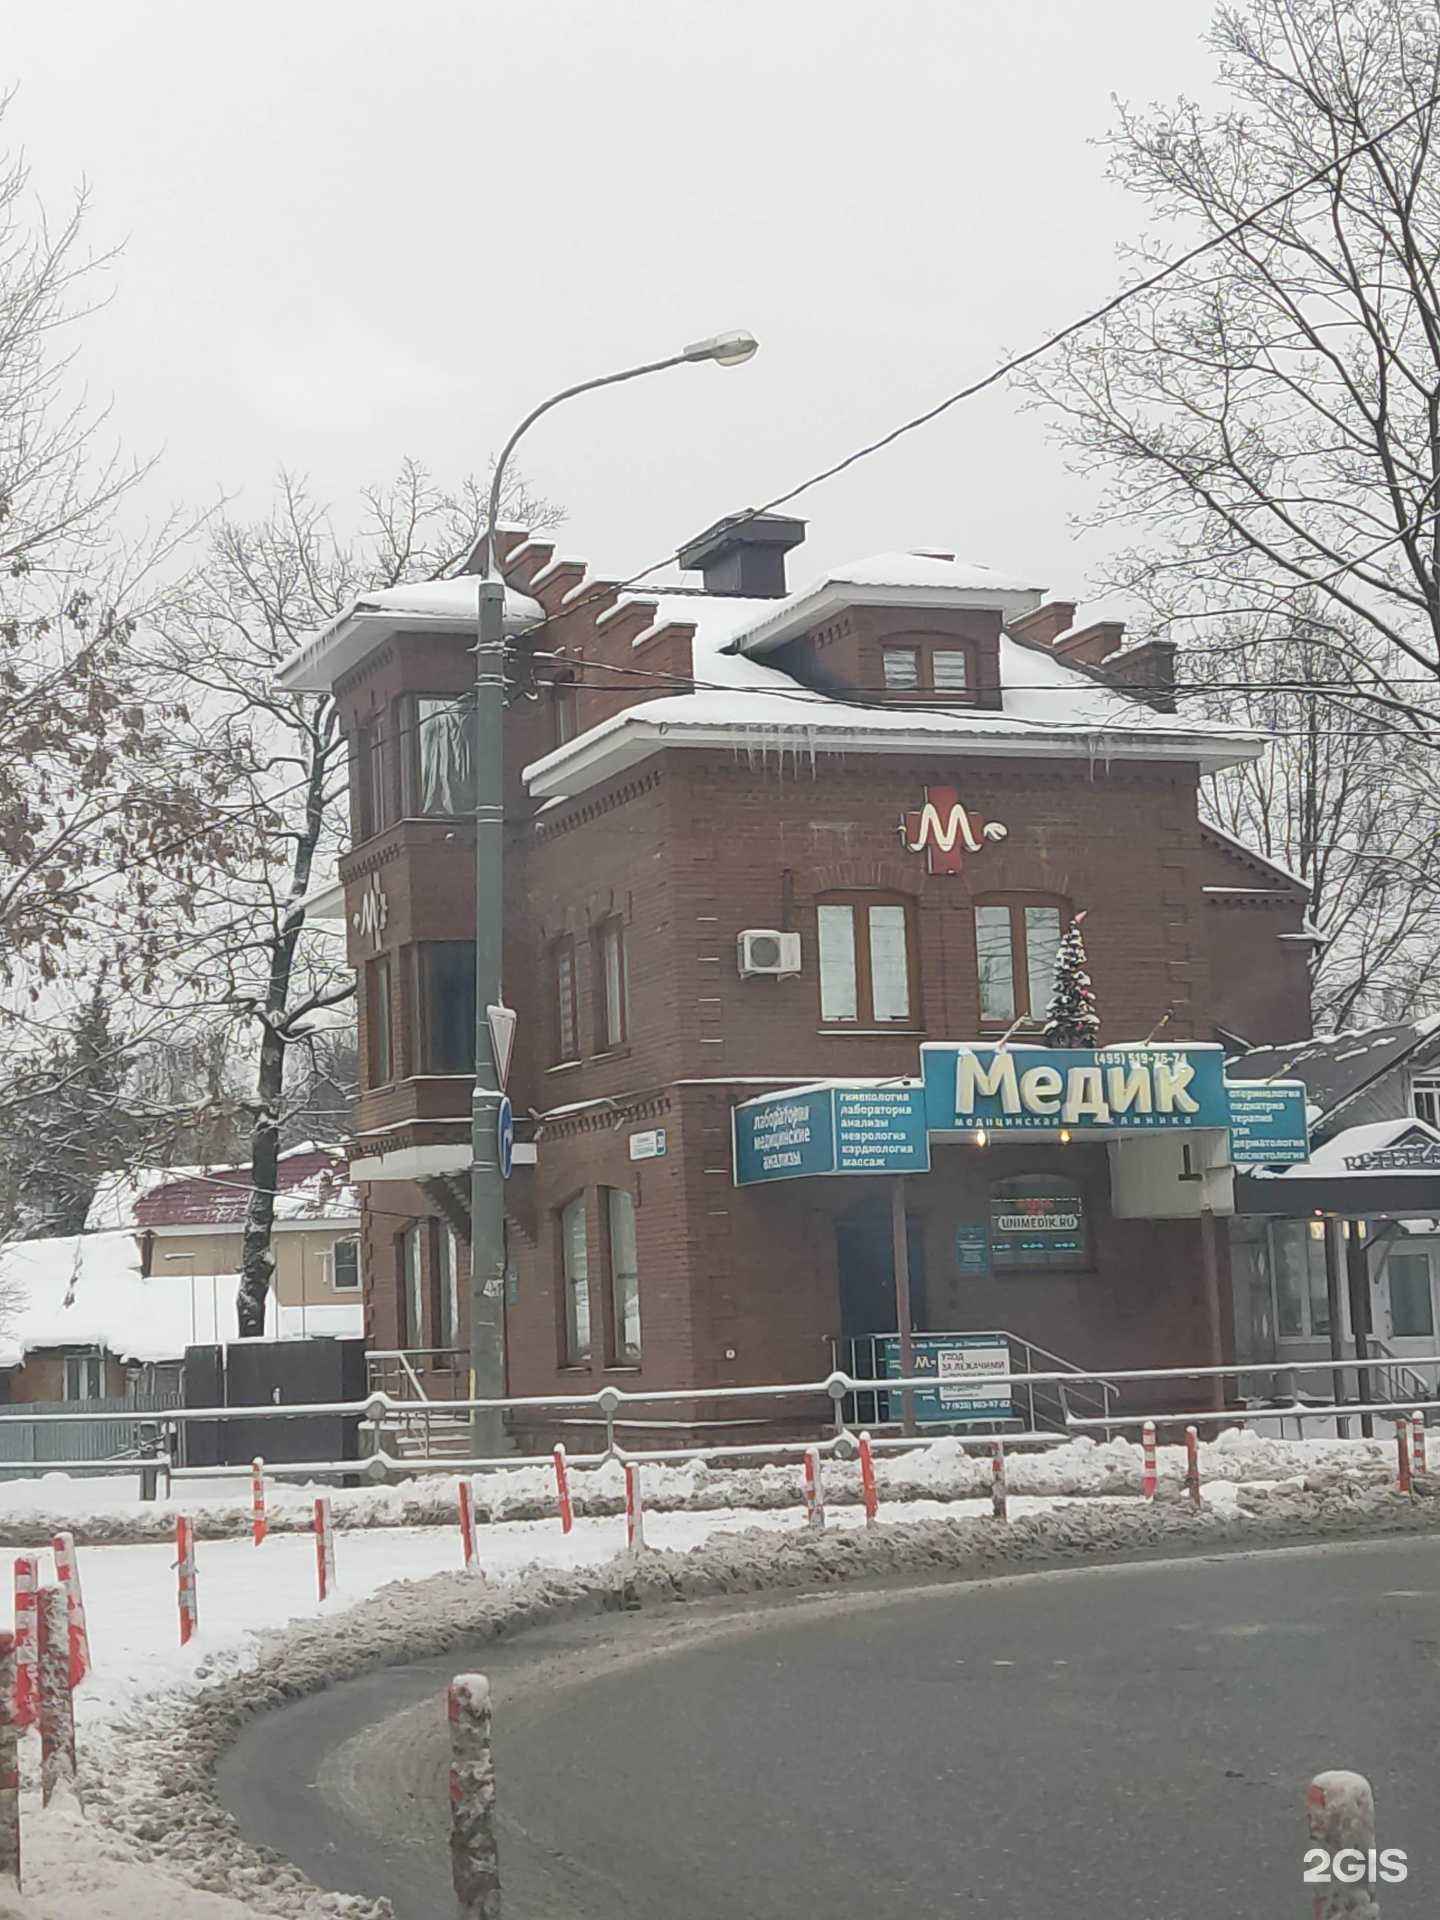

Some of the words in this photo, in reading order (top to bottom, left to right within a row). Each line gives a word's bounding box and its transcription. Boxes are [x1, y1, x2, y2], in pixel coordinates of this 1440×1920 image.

[1094, 1052, 1126, 1065] (495)
[954, 1047, 1200, 1124] Медик
[840, 1093, 910, 1102] гинекология
[840, 1103, 913, 1117] лаборатория
[1230, 1102, 1286, 1113] педиатрия
[840, 1118, 889, 1128] анализы
[954, 1117, 1060, 1127] медицинская
[1231, 1114, 1273, 1125] терапия
[753, 1127, 811, 1152] медицинские
[841, 1131, 907, 1144] неврология
[1232, 1139, 1306, 1149] дерматология
[841, 1144, 914, 1156] кардиология
[762, 1150, 803, 1171] анализы
[842, 1157, 886, 1167] массаж
